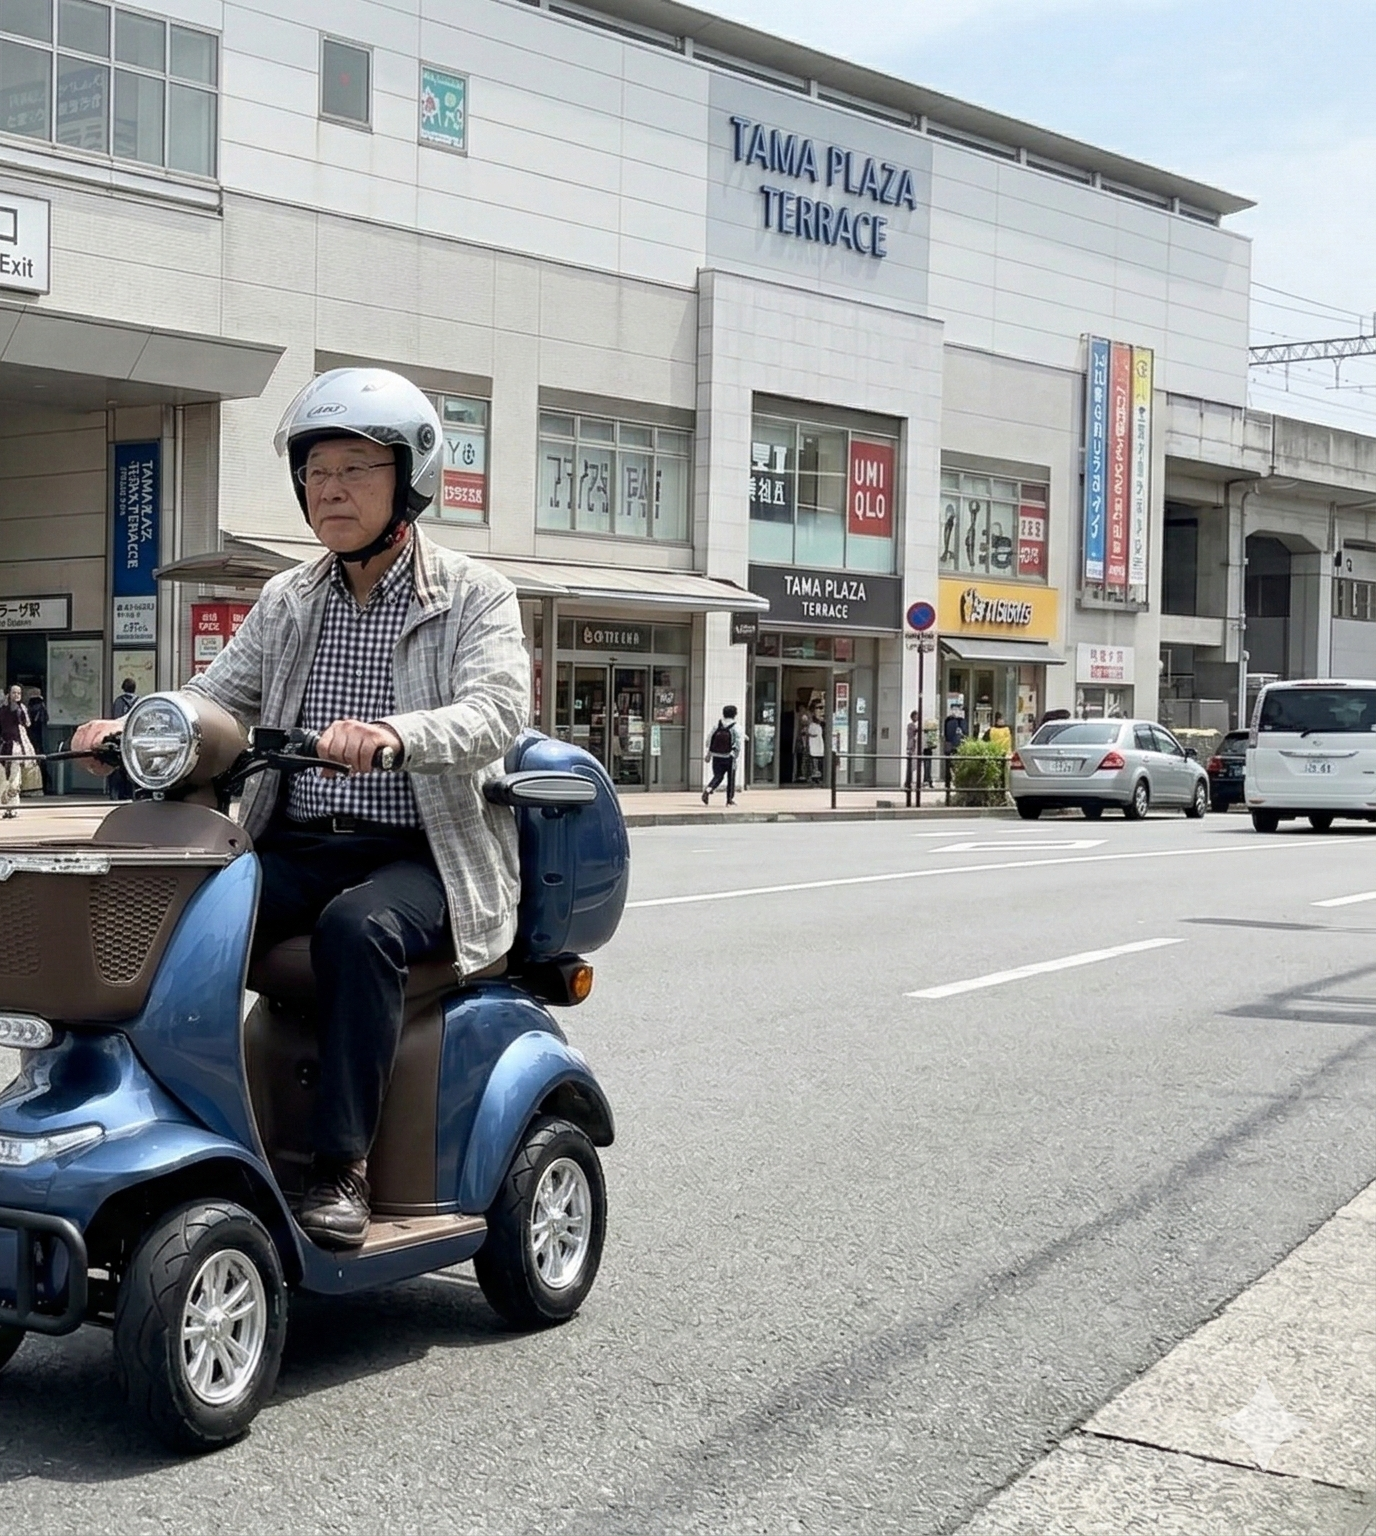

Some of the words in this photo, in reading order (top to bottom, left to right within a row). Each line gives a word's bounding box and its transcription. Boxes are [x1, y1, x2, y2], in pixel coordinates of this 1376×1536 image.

[730, 116, 820, 183] TAMA
[826, 146, 917, 211] PLAZA
[760, 184, 888, 258] TERRACE
[0, 252, 34, 279] Exit
[854, 458, 884, 489] UMI
[854, 490, 886, 521] QLO
[784, 576, 821, 597] TAMA
[825, 579, 866, 601] PLAZA
[802, 601, 848, 619] TERRACE
